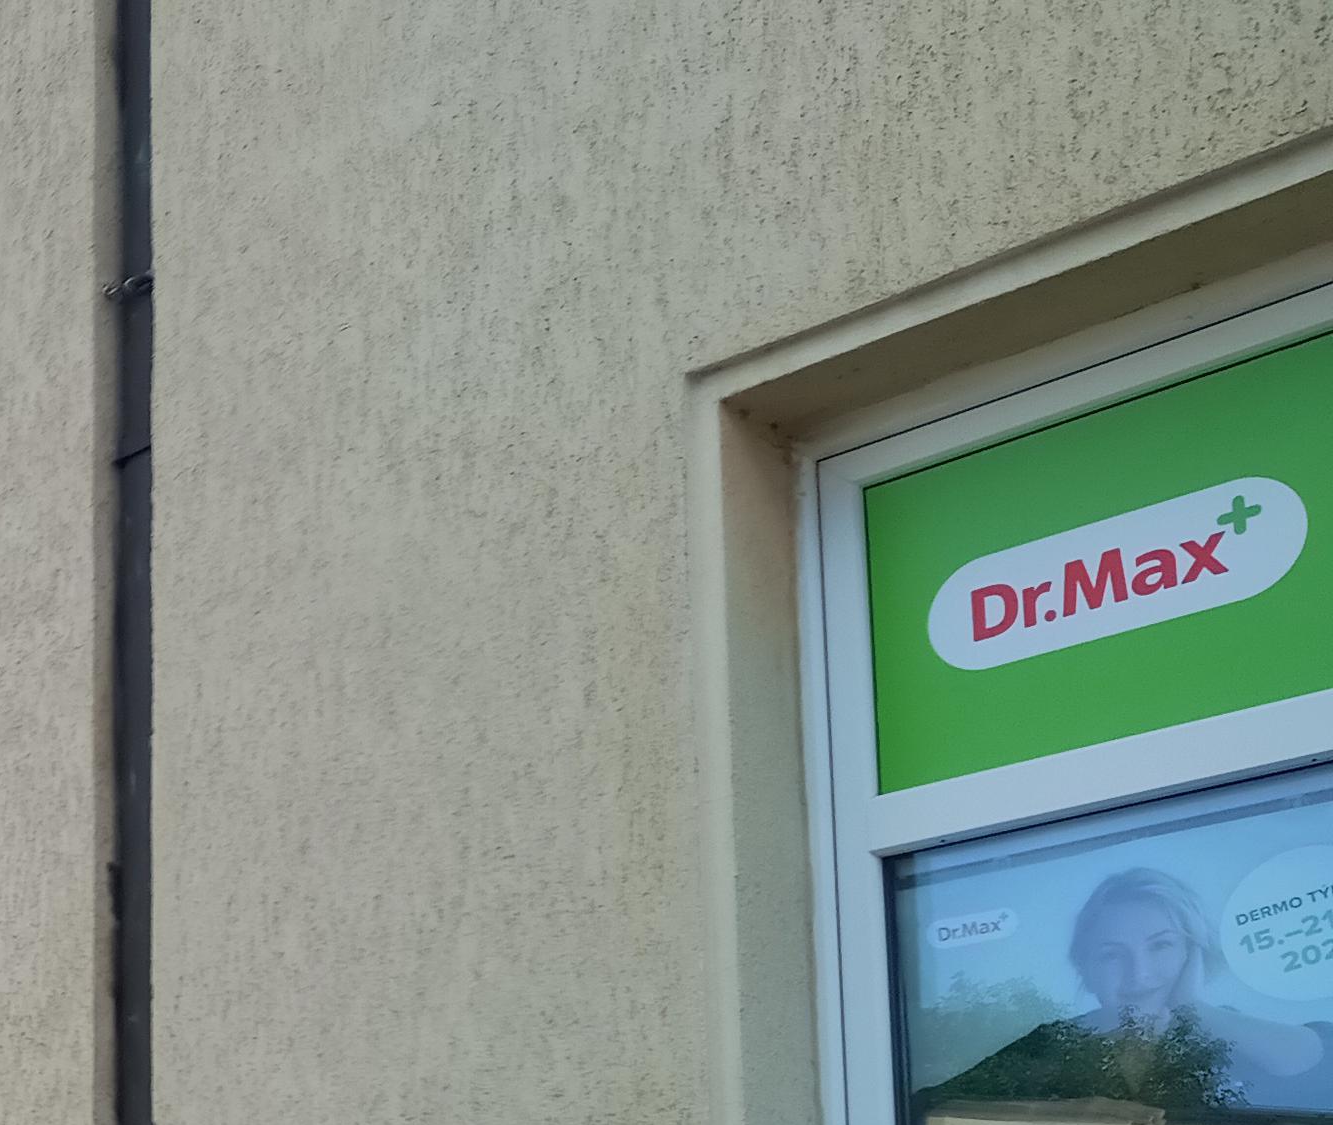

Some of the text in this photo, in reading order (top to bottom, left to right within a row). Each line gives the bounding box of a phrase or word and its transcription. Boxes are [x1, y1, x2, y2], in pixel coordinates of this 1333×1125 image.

[970, 530, 1230, 642] Dr.Max
[1234, 882, 1333, 926] DERMO TÝ
[937, 918, 1002, 943] Dr.Max
